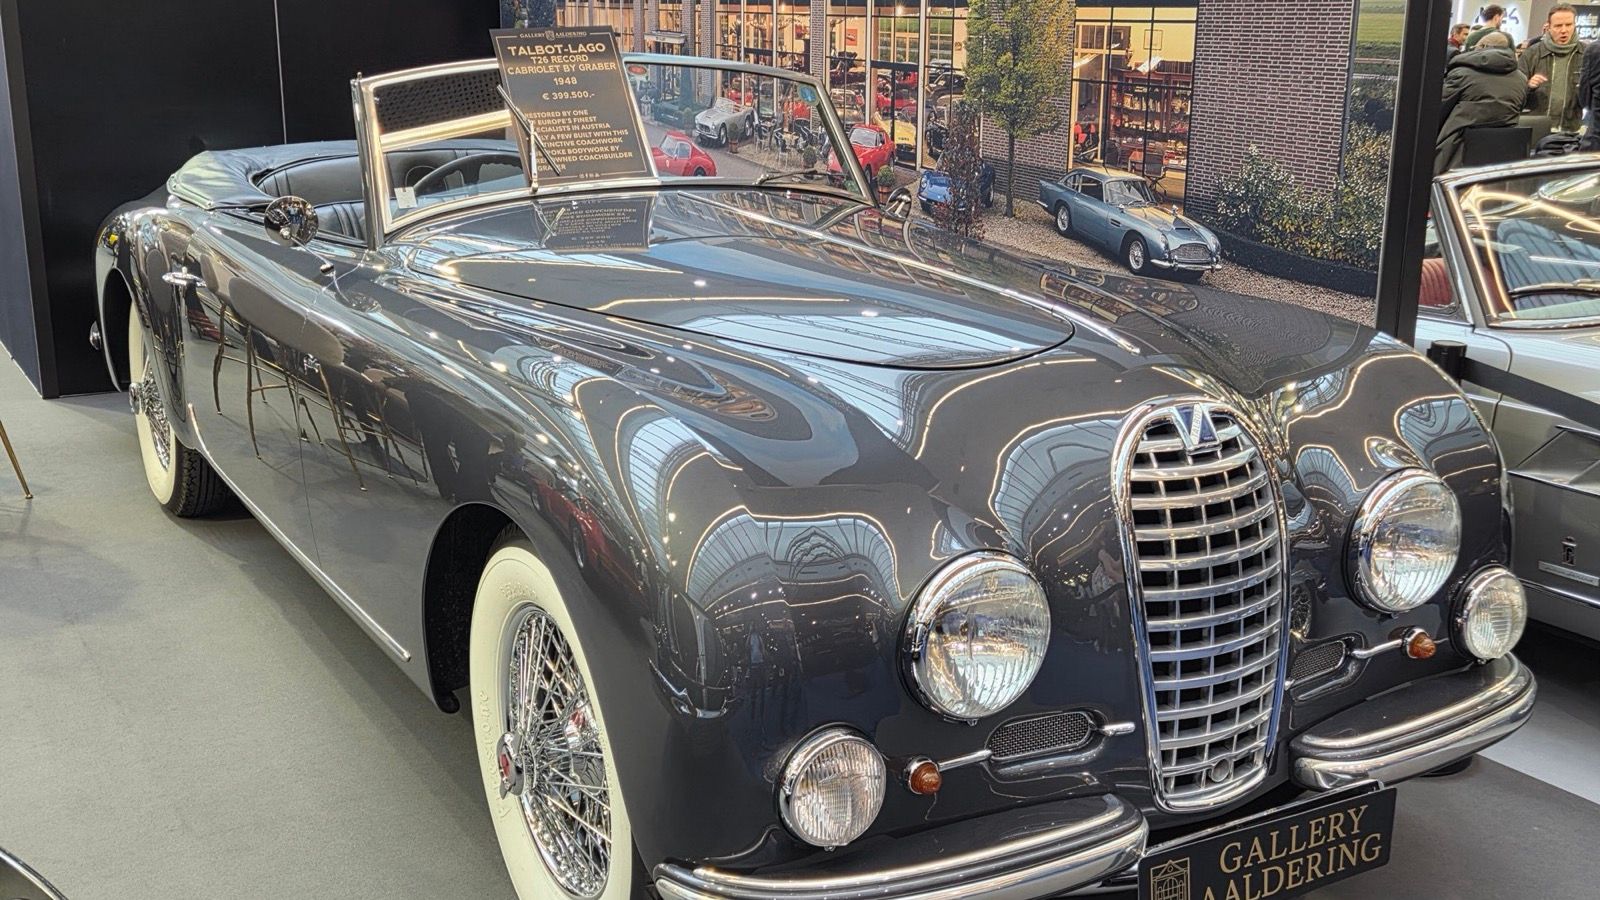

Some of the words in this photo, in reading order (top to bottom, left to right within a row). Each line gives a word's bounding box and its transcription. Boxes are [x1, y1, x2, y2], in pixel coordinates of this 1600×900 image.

[507, 43, 605, 56] TALBOT-LAGO
[530, 55, 549, 64] T26
[550, 54, 589, 64] RECORD
[507, 65, 560, 75] CABRIOLET
[562, 63, 576, 72] BY
[578, 62, 617, 71] GRABER
[553, 76, 577, 85] 1948
[542, 92, 550, 100] €
[581, 122, 611, 130] AUSTRIA
[573, 131, 592, 139] BUILT
[592, 130, 612, 138] WITH
[612, 128, 629, 136] THIS
[576, 137, 623, 145] COACHWORK
[567, 146, 610, 155] BODYWORK
[578, 152, 633, 160] COACHBUILDER
[1219, 804, 1368, 874] GALLERY
[1201, 833, 1382, 900] AALDERING
